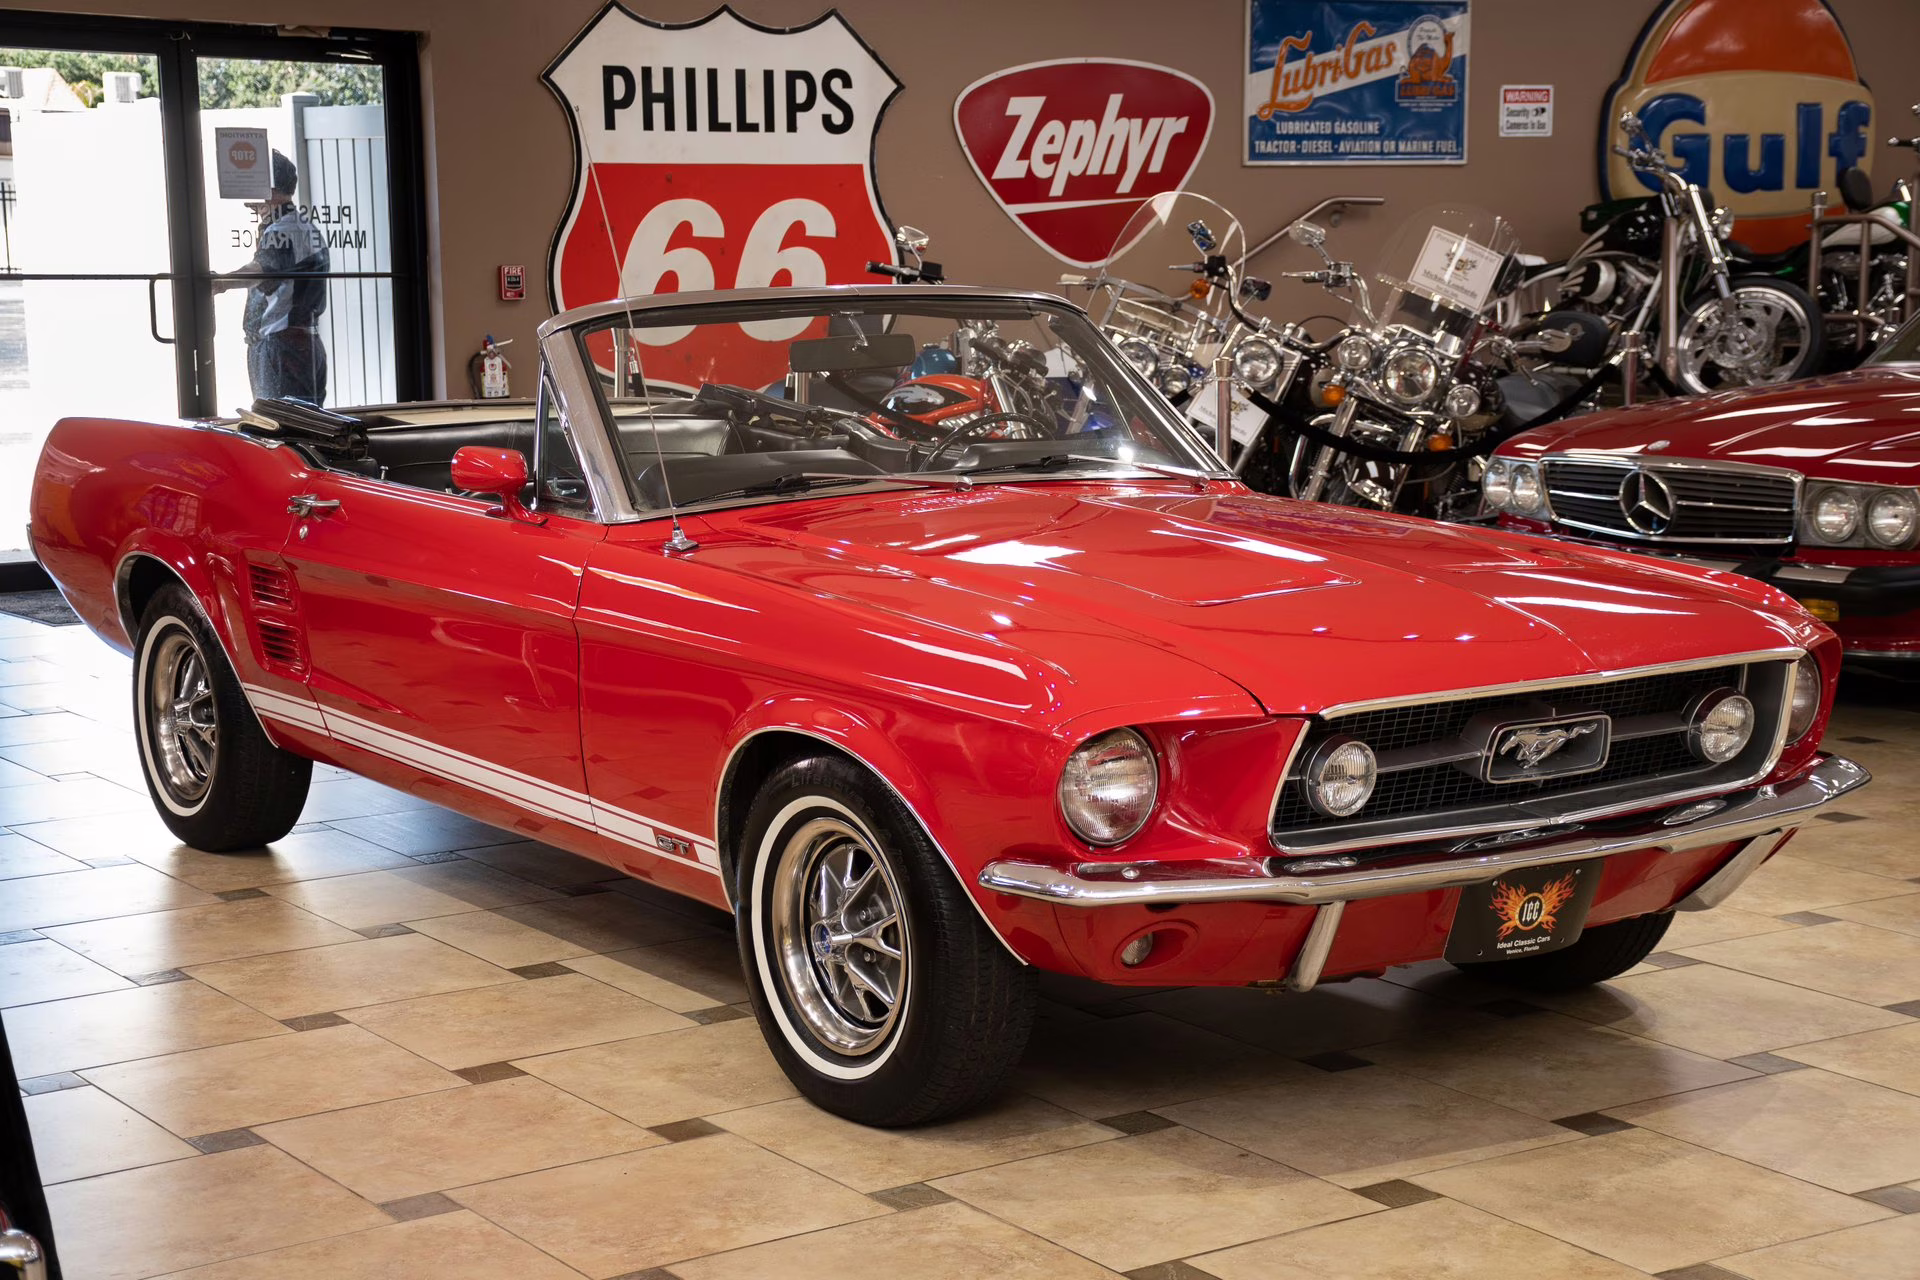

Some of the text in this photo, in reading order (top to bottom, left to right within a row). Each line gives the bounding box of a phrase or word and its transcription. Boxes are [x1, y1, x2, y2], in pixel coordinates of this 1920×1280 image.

[602, 65, 854, 135] PHILLIPS
[1505, 90, 1549, 102] WARNING
[1506, 107, 1530, 119] Security
[1276, 121, 1380, 135] LUBRICATED GASOLINE
[991, 94, 1190, 197] Zephyr
[1338, 140, 1381, 153] AVIATION
[1383, 140, 1397, 153] OR
[1398, 140, 1435, 153] MARINE
[1629, 92, 1872, 194] Gulf
[504, 266, 522, 275] FIRE
[617, 197, 837, 347] 66
[656, 834, 690, 855] GT
[1522, 900, 1540, 922] ICC
[1497, 935, 1551, 949] Ideal Classic Cars
